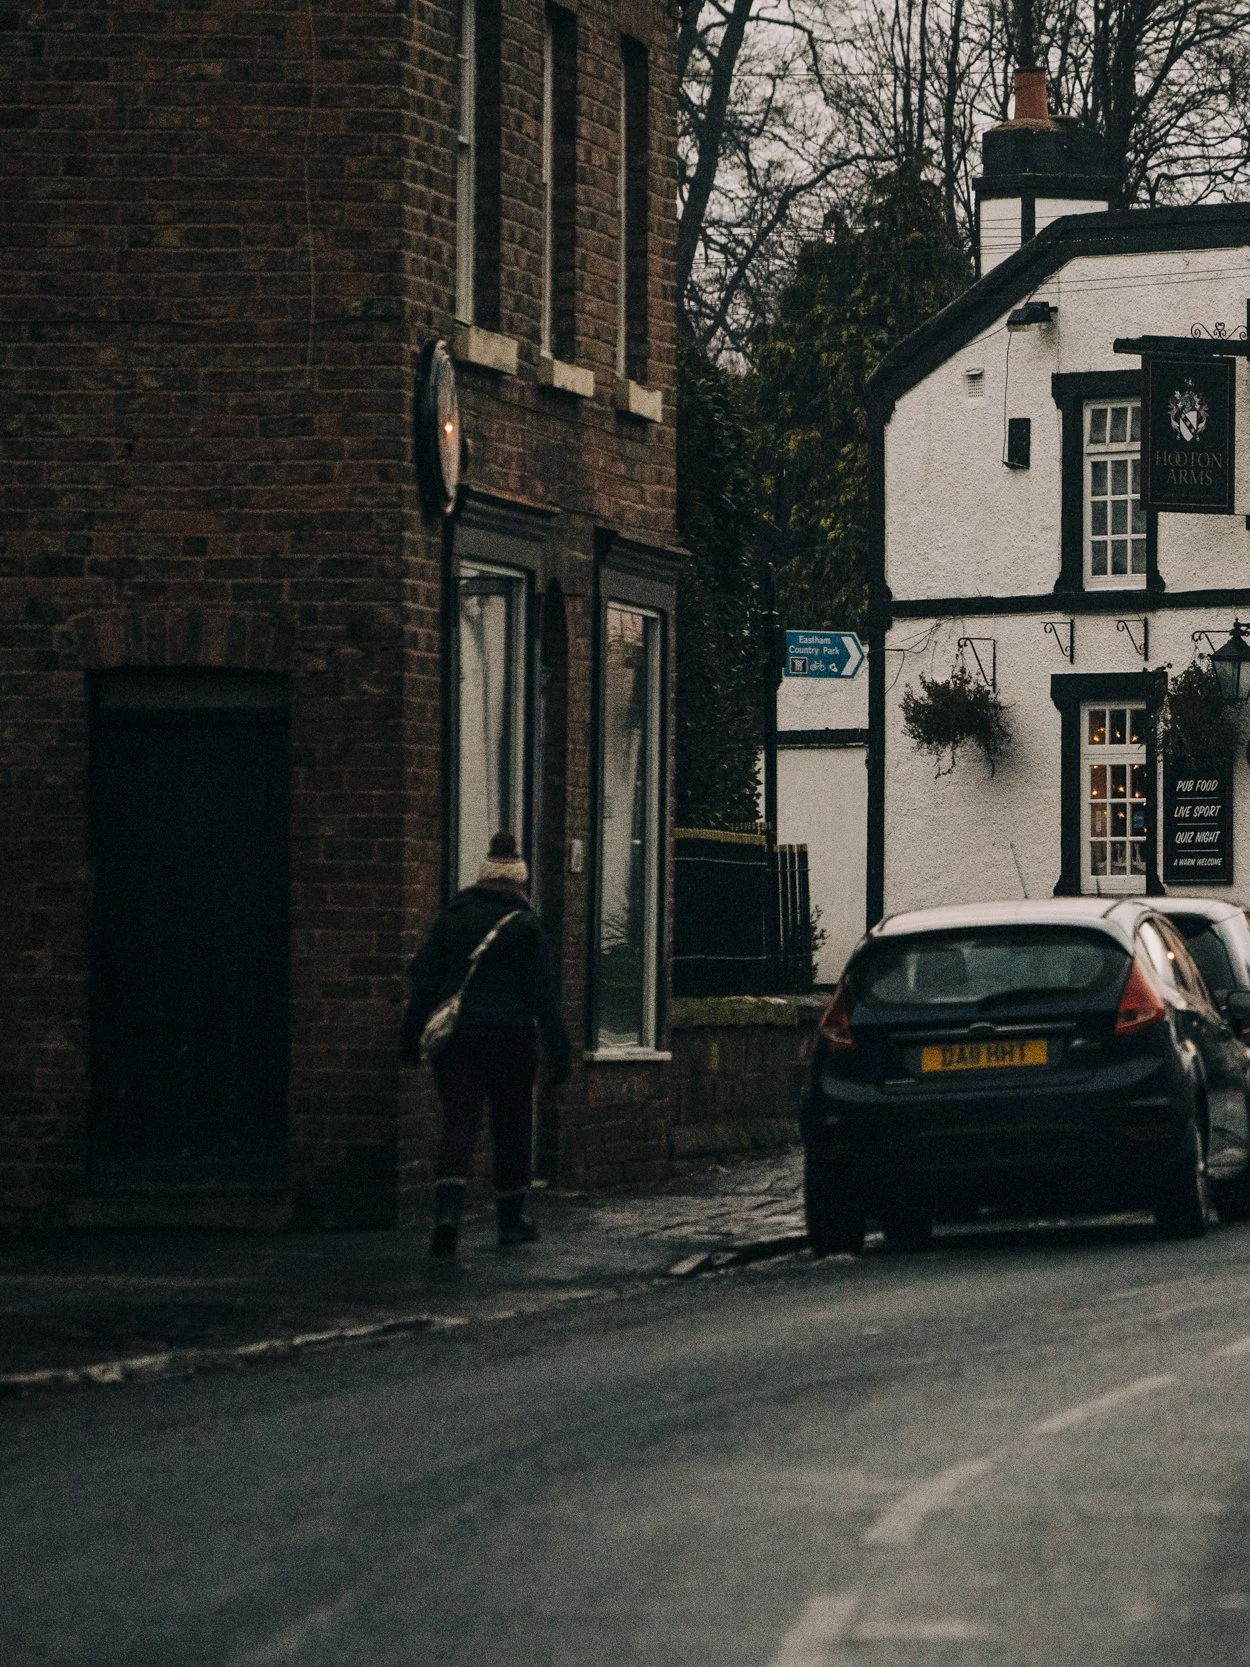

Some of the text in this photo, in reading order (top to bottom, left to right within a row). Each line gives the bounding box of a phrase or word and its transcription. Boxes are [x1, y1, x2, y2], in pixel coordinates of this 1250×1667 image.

[1155, 450, 1223, 469] HOOTON
[1166, 468, 1213, 486] ARMS
[798, 635, 831, 644] Eastham
[788, 646, 840, 655] Country Park
[1176, 780, 1219, 792] PUB FOOD
[1174, 805, 1221, 817] LIVE SPORT
[1175, 831, 1220, 844] QUIZ NIGHT
[1179, 858, 1196, 866] WARM
[1197, 858, 1223, 866] WELCOME
